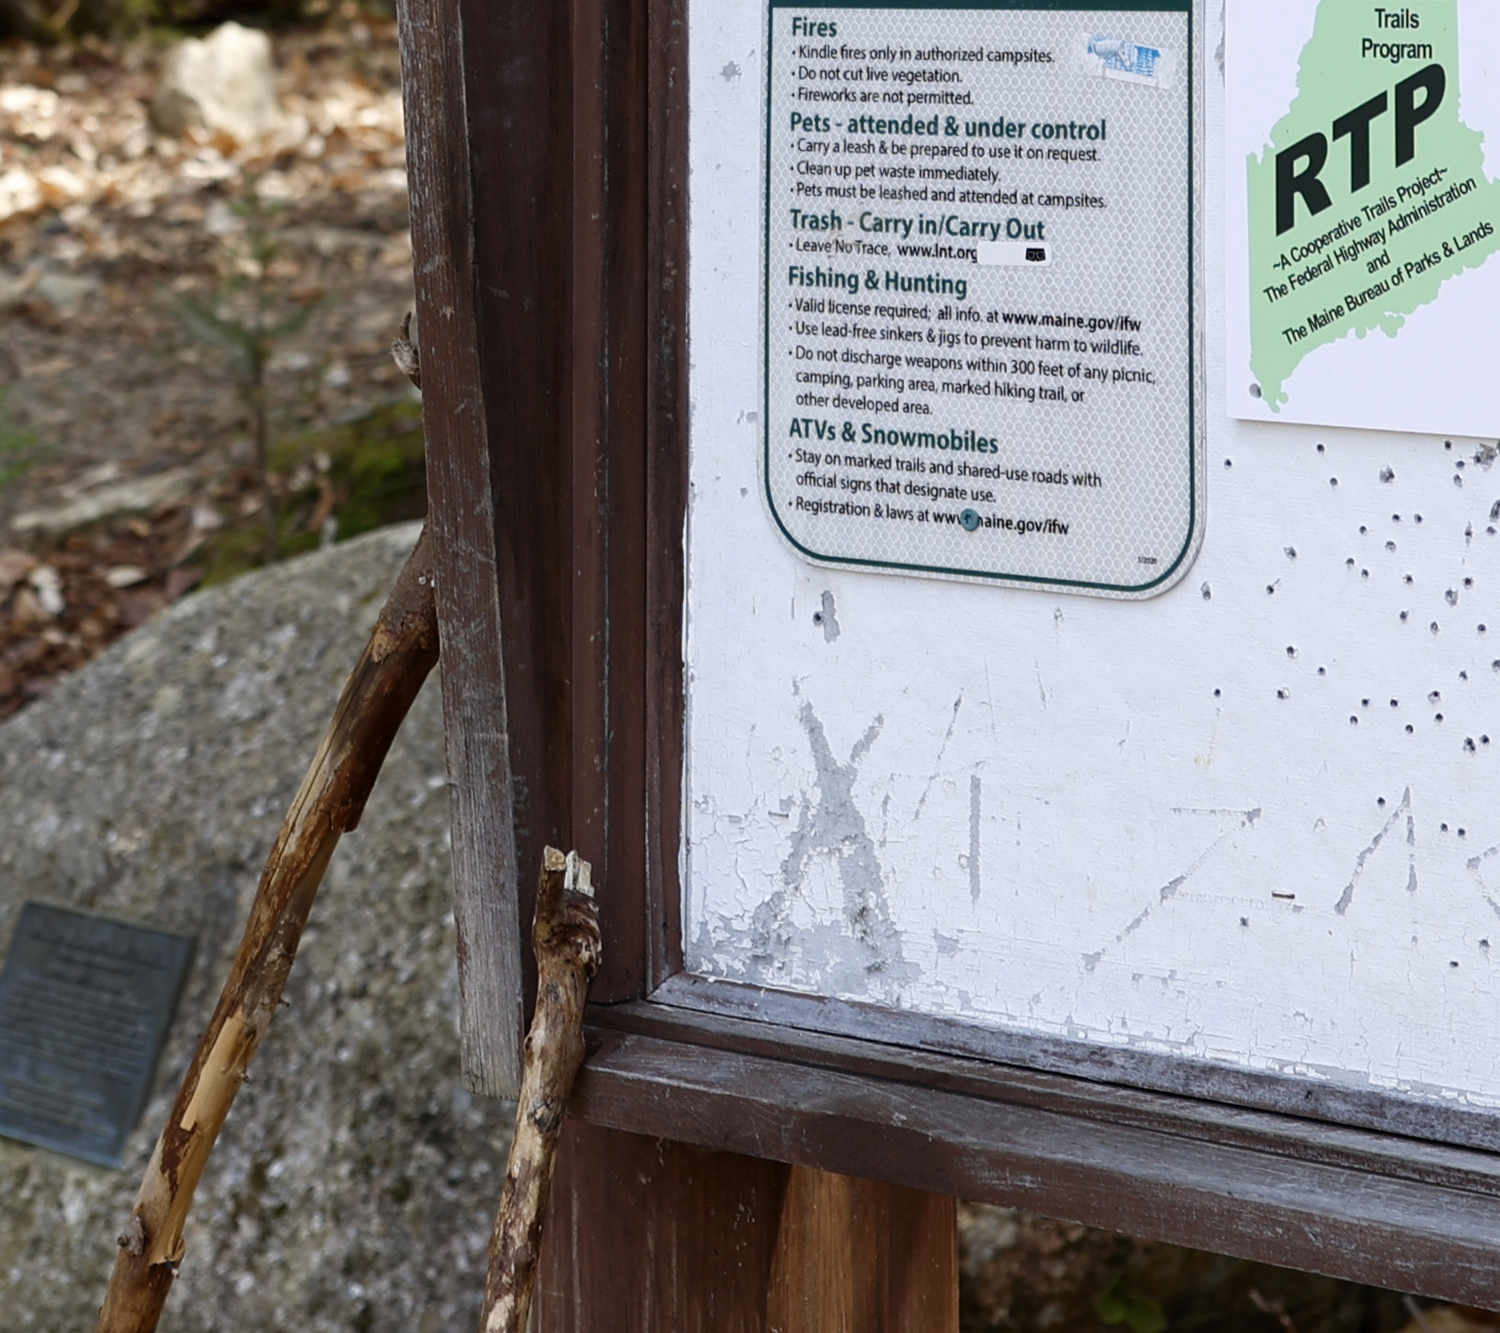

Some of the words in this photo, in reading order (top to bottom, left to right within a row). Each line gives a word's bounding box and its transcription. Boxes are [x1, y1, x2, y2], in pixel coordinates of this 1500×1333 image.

[792, 16, 837, 37] Fires
[1374, 8, 1419, 28] Trails
[799, 45, 837, 59] Kindle
[840, 44, 866, 59] fires
[869, 46, 897, 63] only
[900, 47, 911, 60] in
[915, 46, 983, 61] authorized
[986, 48, 1055, 66] campsites.
[1362, 38, 1432, 64] Program
[791, 112, 830, 132] Pets
[848, 114, 938, 135] attended
[945, 116, 959, 136] &
[965, 116, 1026, 138] under
[1031, 119, 1106, 141] control
[1275, 63, 1446, 237] RTP
[790, 209, 842, 231] Trash
[860, 212, 913, 239] Carry
[919, 214, 1001, 241] in/Carry
[1006, 218, 1044, 240] Out
[1263, 284, 1289, 304] The
[1288, 254, 1334, 290] Federal
[1333, 228, 1386, 265] Highway
[1387, 177, 1477, 236] Administration
[1290, 215, 1362, 263] Cooperative
[1360, 195, 1397, 222] Trails
[1366, 250, 1391, 274] and
[789, 266, 859, 294] Fishing
[864, 270, 879, 290] &
[885, 271, 967, 300] Hunting
[1282, 326, 1308, 345] The
[1306, 303, 1345, 332] Maine
[1343, 280, 1390, 312] Bureau
[1390, 268, 1405, 286] of
[1403, 252, 1442, 279] Parks
[1442, 241, 1455, 259] &
[1453, 220, 1494, 251] Lands
[790, 418, 836, 440] ATVs
[841, 422, 856, 442] &
[862, 423, 998, 454] Snowmobiles
